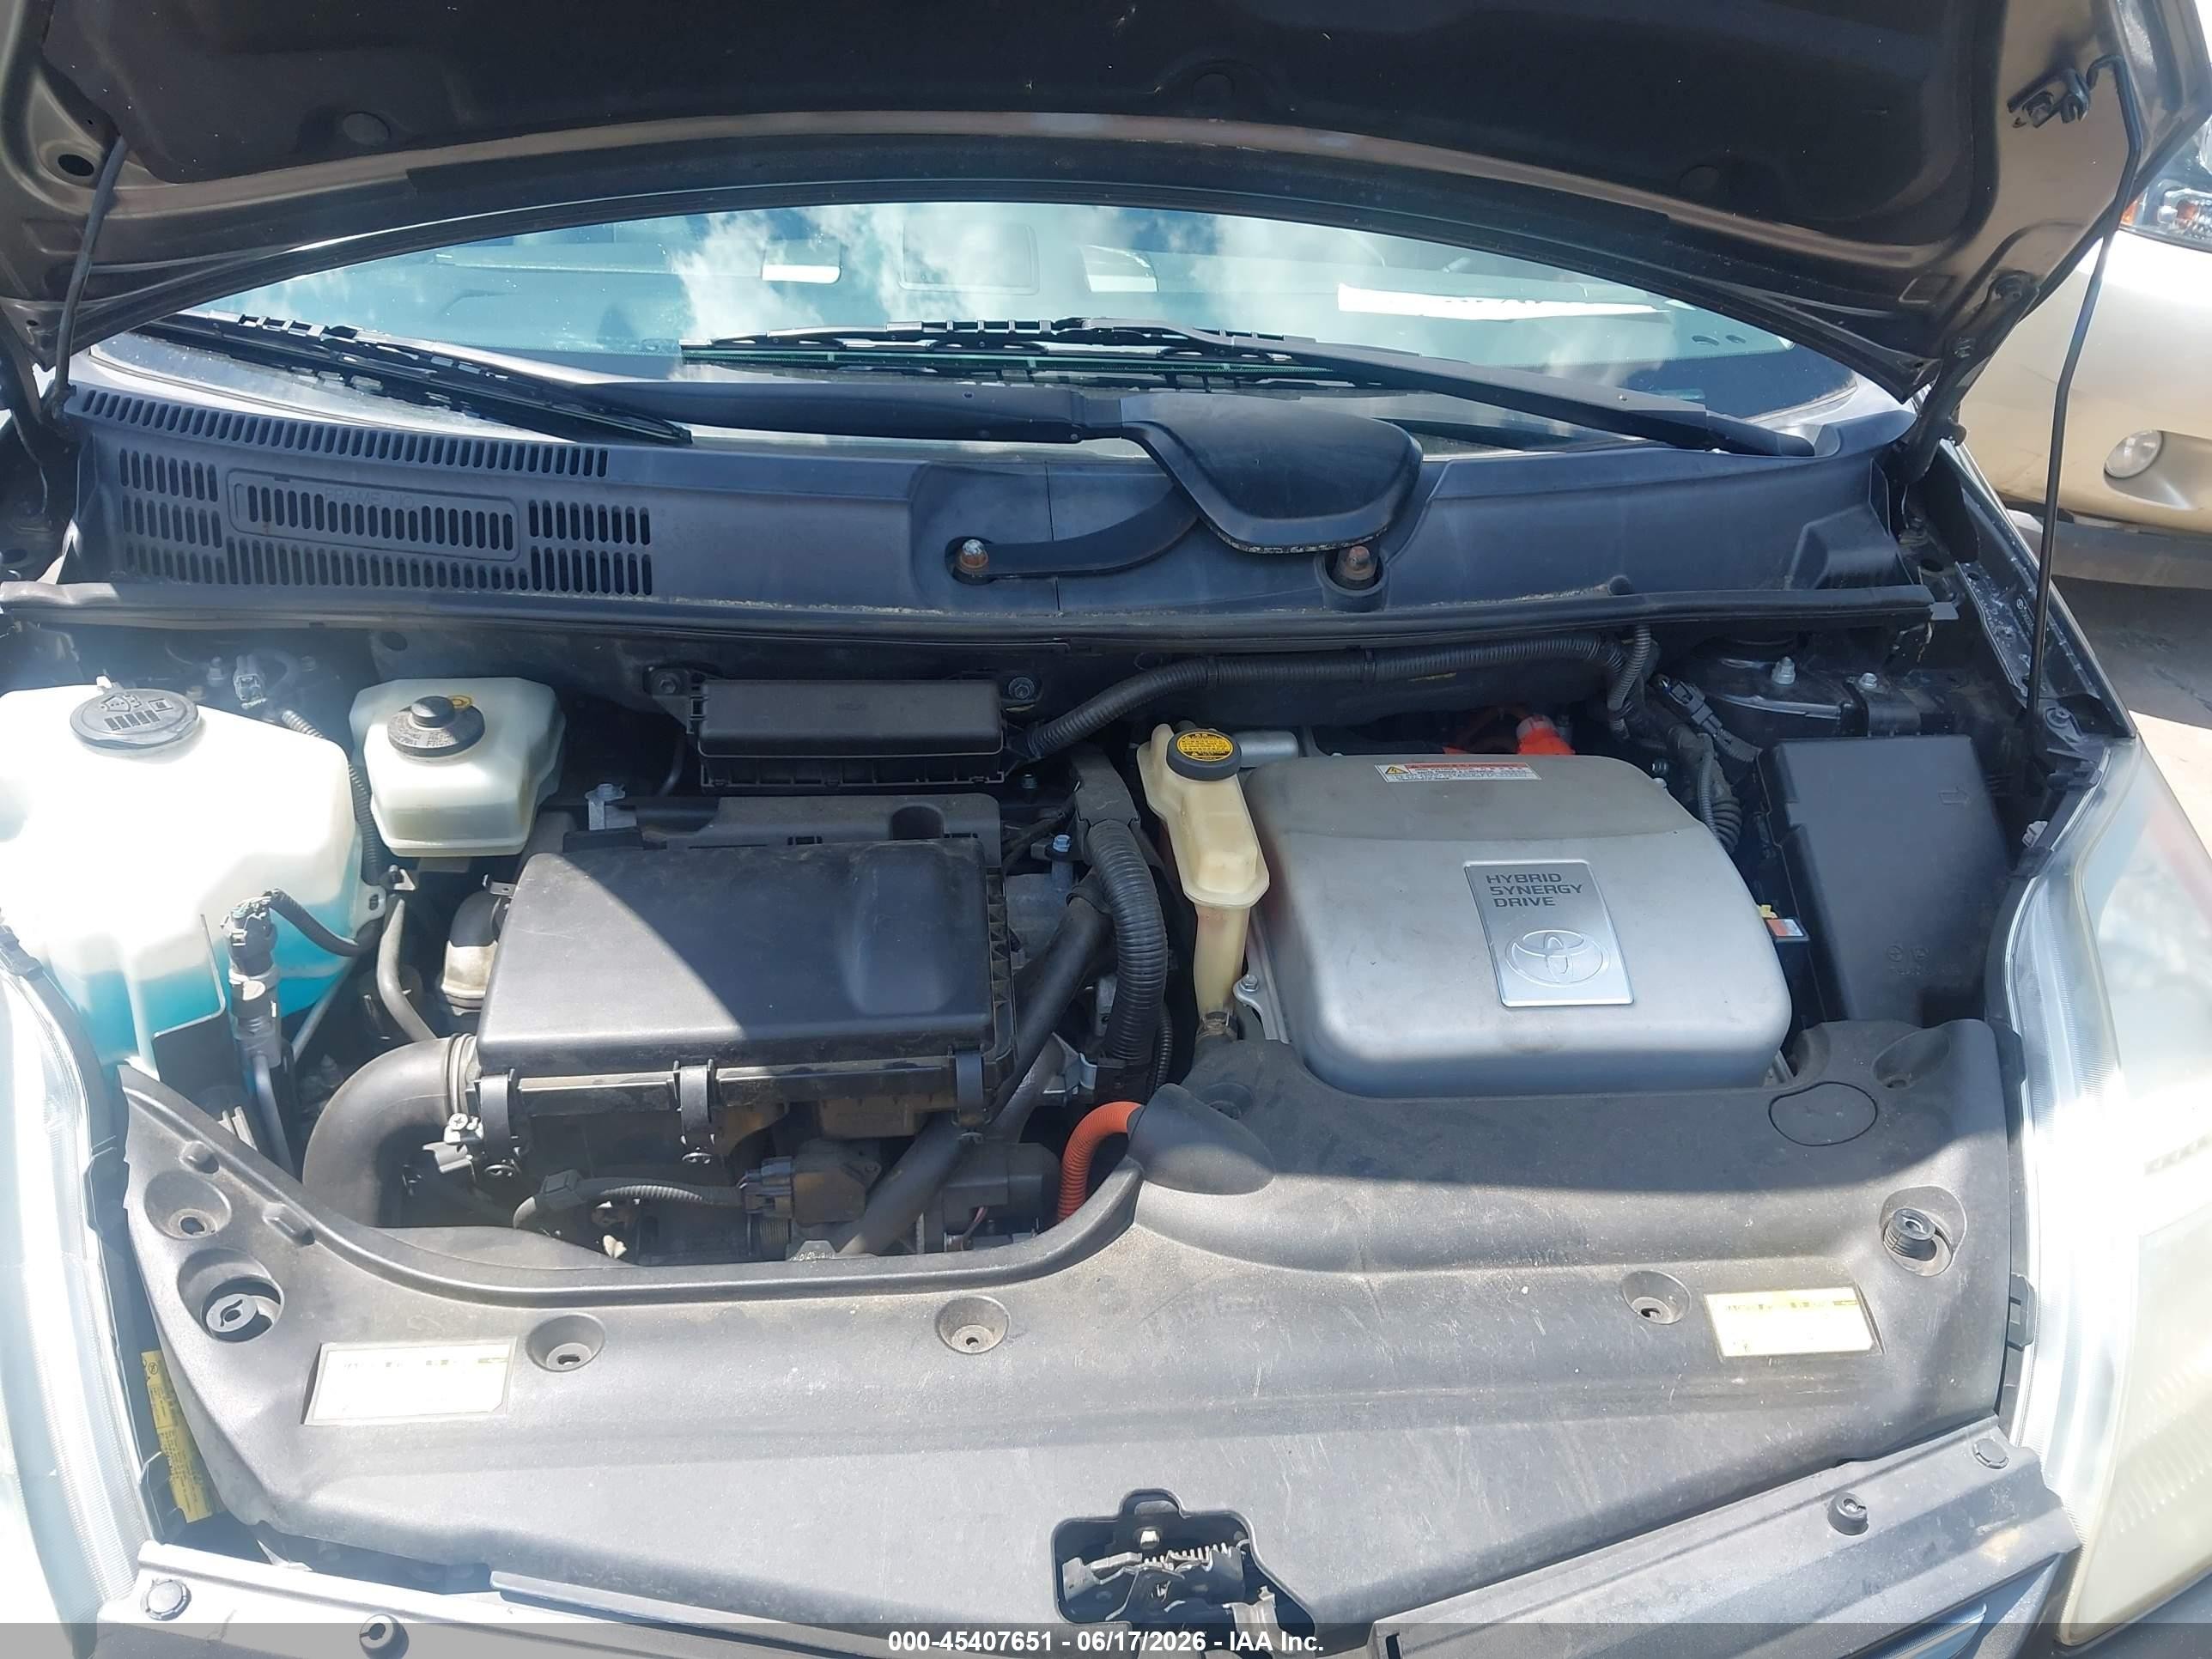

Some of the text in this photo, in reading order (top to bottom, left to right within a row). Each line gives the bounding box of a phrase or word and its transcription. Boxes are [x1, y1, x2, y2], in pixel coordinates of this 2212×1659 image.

[1486, 873, 1561, 884] HYBRID
[1490, 884, 1583, 896] SYNERGY
[1494, 896, 1555, 908] DRIVE
